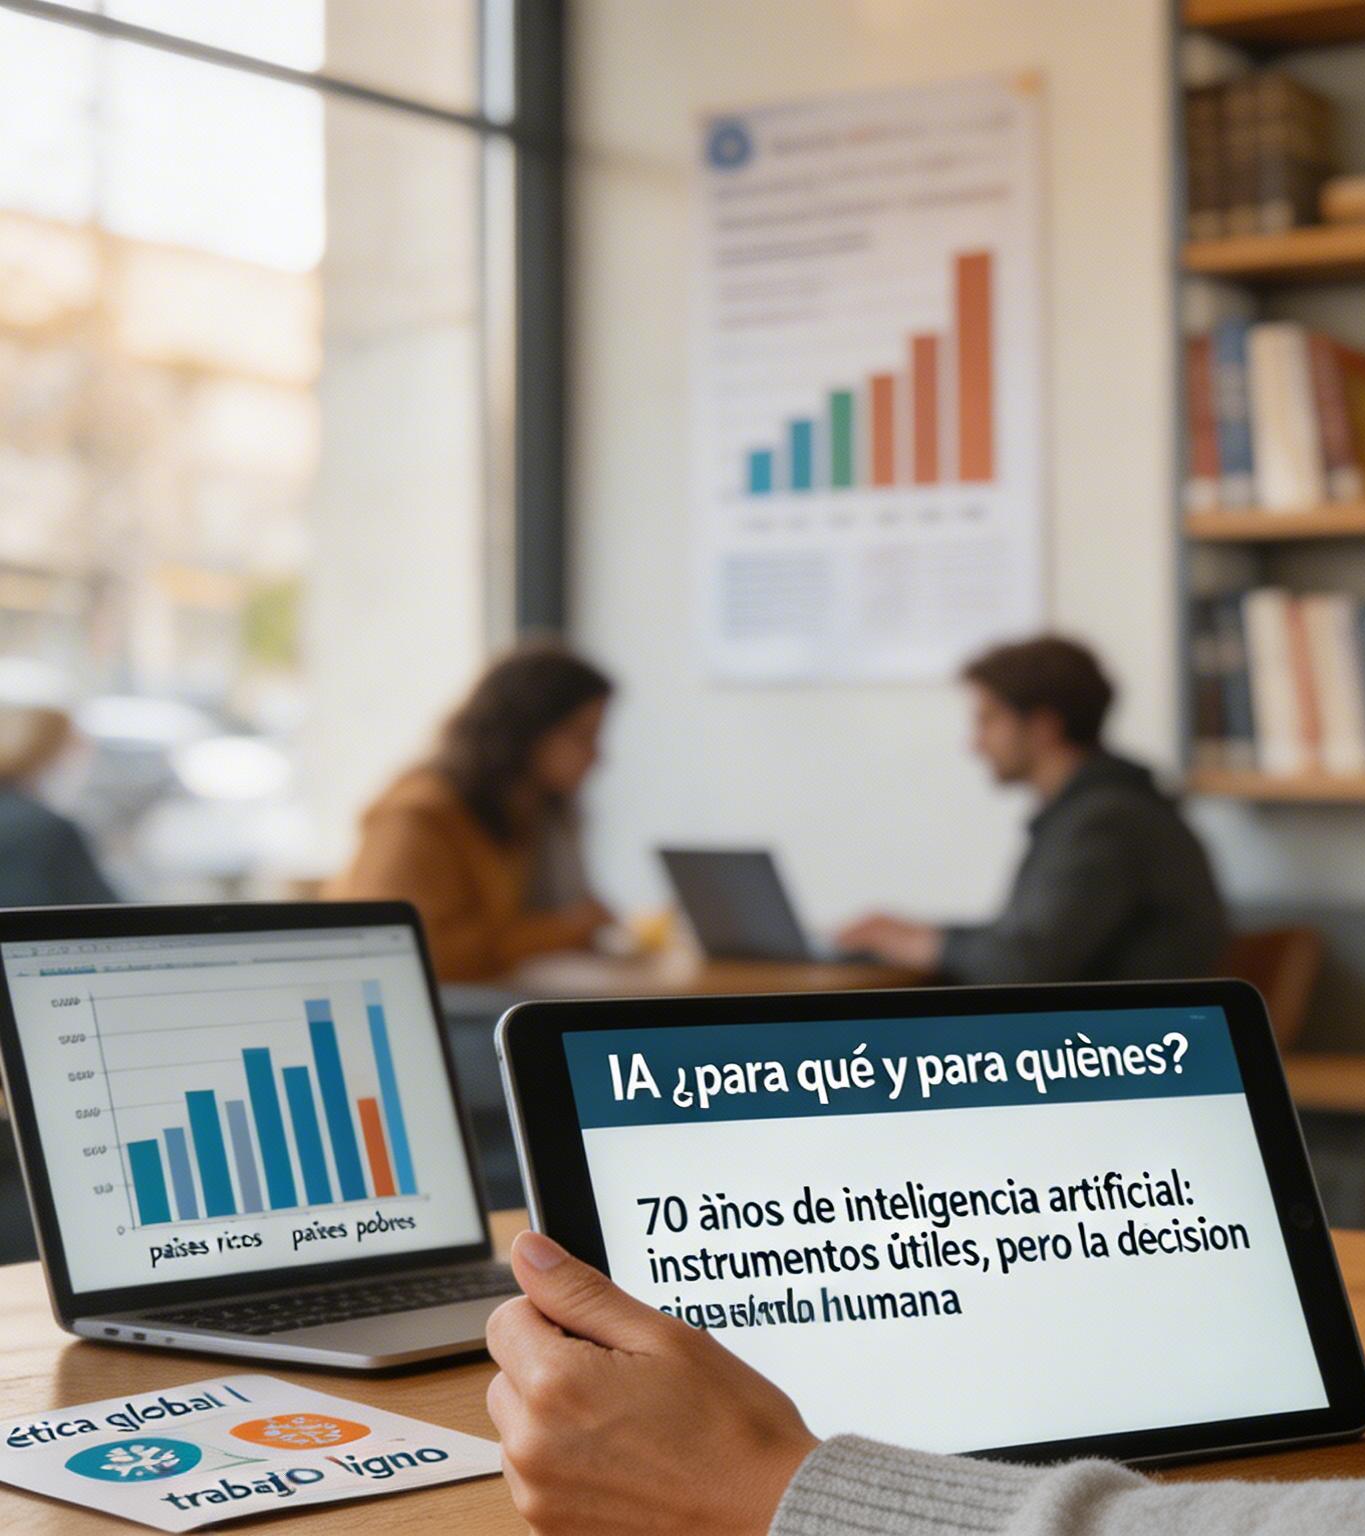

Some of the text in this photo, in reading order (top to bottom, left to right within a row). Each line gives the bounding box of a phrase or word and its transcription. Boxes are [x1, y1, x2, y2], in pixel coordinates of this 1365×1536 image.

[608, 1053, 662, 1101] IA
[672, 1060, 789, 1109] ¿para
[797, 1042, 875, 1104] qué
[881, 1056, 907, 1100] y
[916, 1051, 1008, 1098] para
[357, 1211, 417, 1242] pobres
[636, 1195, 688, 1235] 70
[793, 1186, 836, 1225] de
[842, 1178, 1041, 1228] inteligencia
[1048, 1168, 1194, 1212] artificial:
[647, 1240, 880, 1284] instrumentos
[996, 1233, 1072, 1274] pero
[1078, 1221, 1110, 1258] la
[820, 1286, 962, 1323] humana
[6, 1418, 99, 1448] ética
[105, 1390, 226, 1433] global
